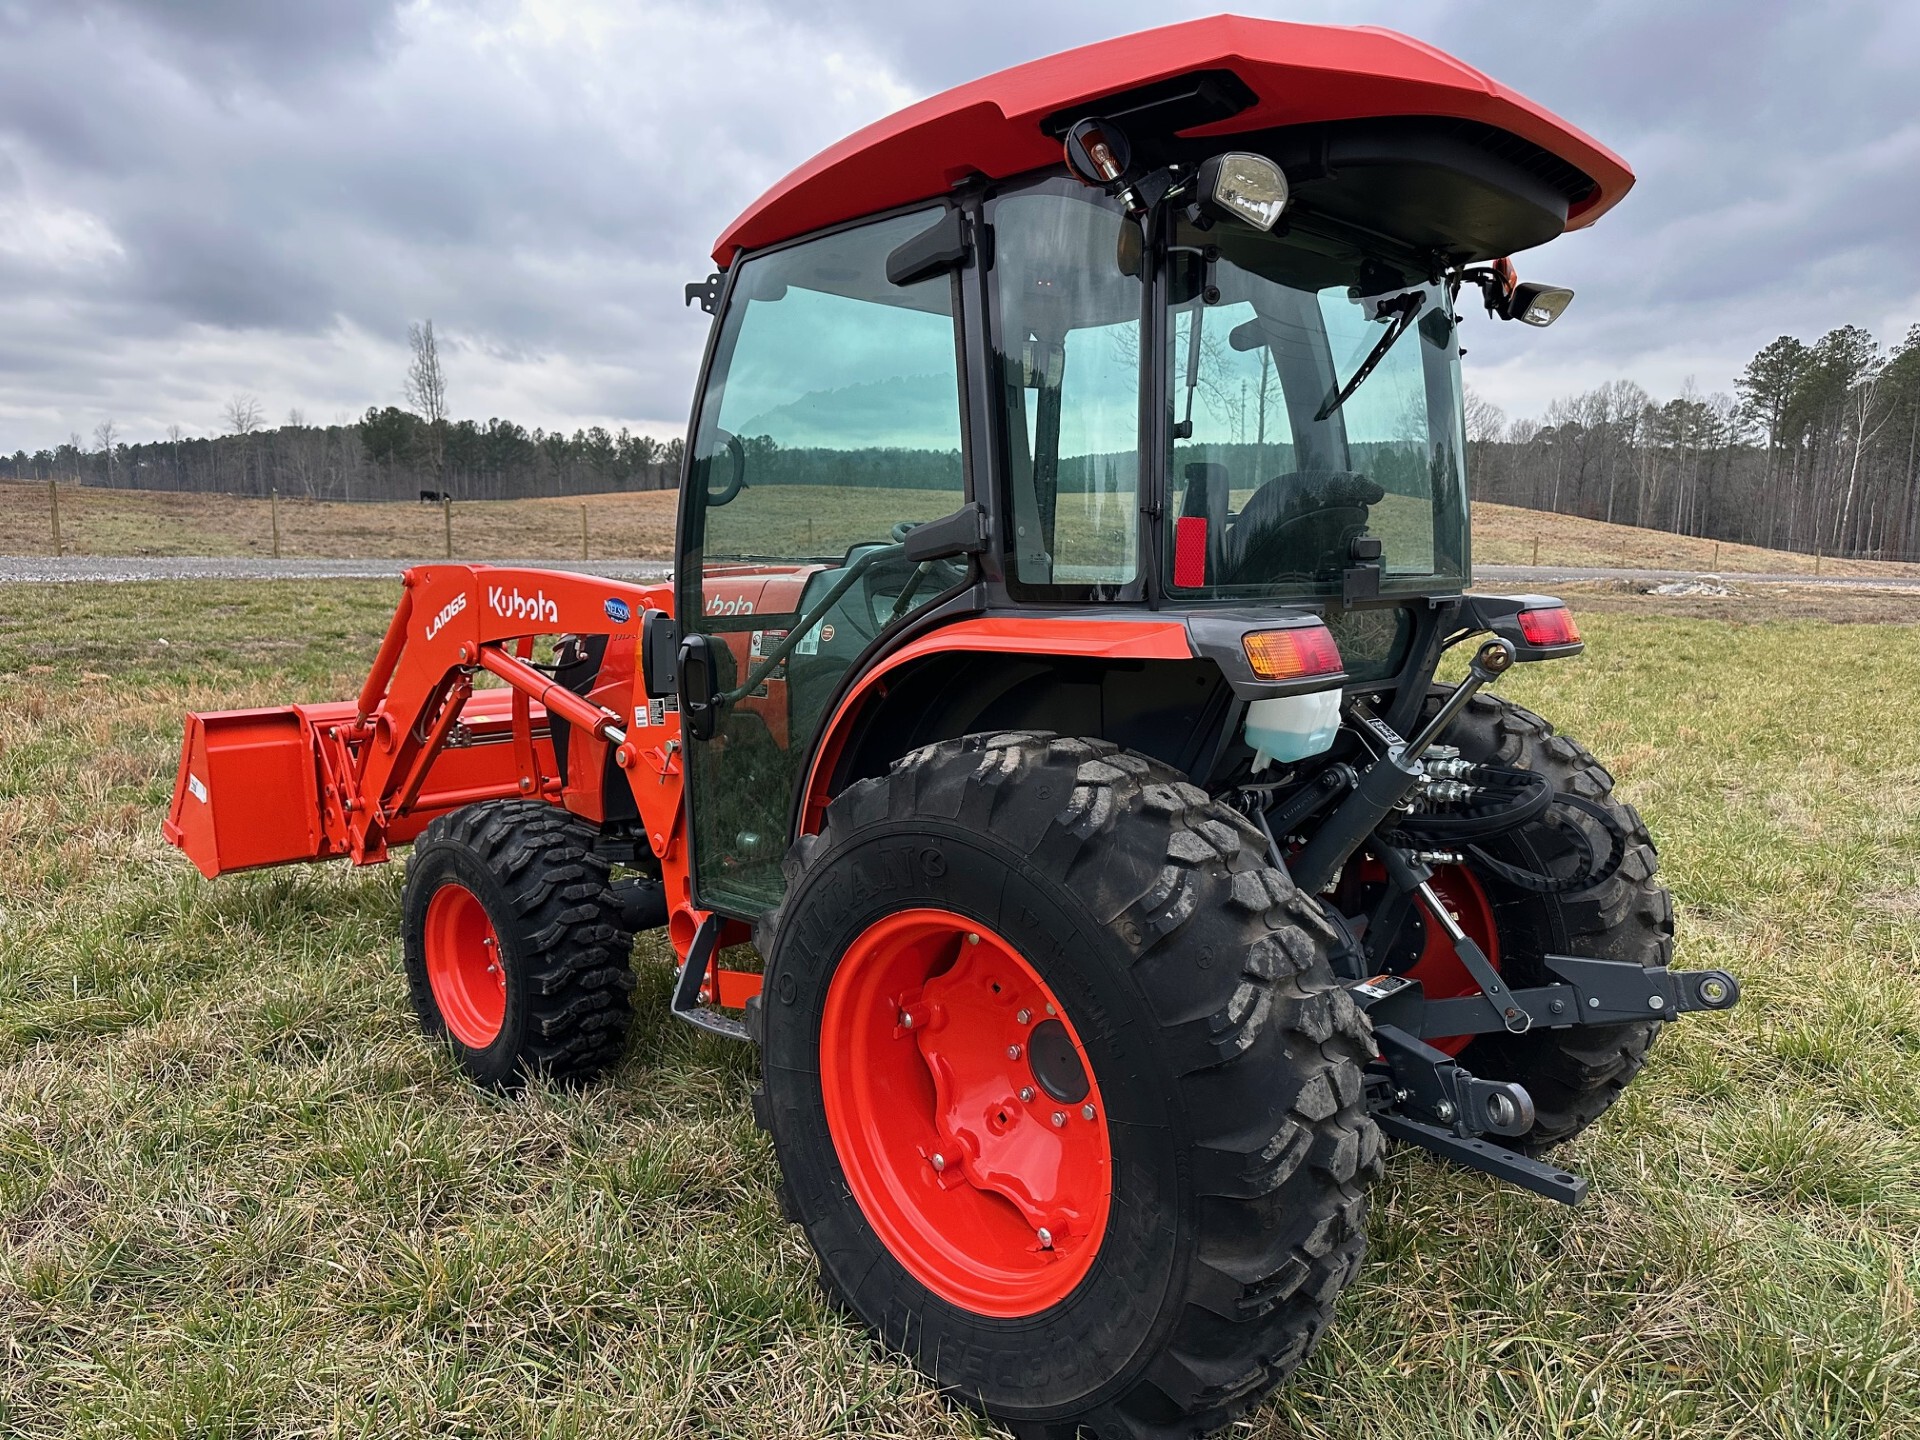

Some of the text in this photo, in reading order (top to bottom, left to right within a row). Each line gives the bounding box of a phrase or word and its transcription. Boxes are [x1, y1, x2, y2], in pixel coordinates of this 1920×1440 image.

[425, 592, 467, 641] LA1065
[488, 585, 558, 623] Kubota
[786, 846, 915, 976] TITAN
